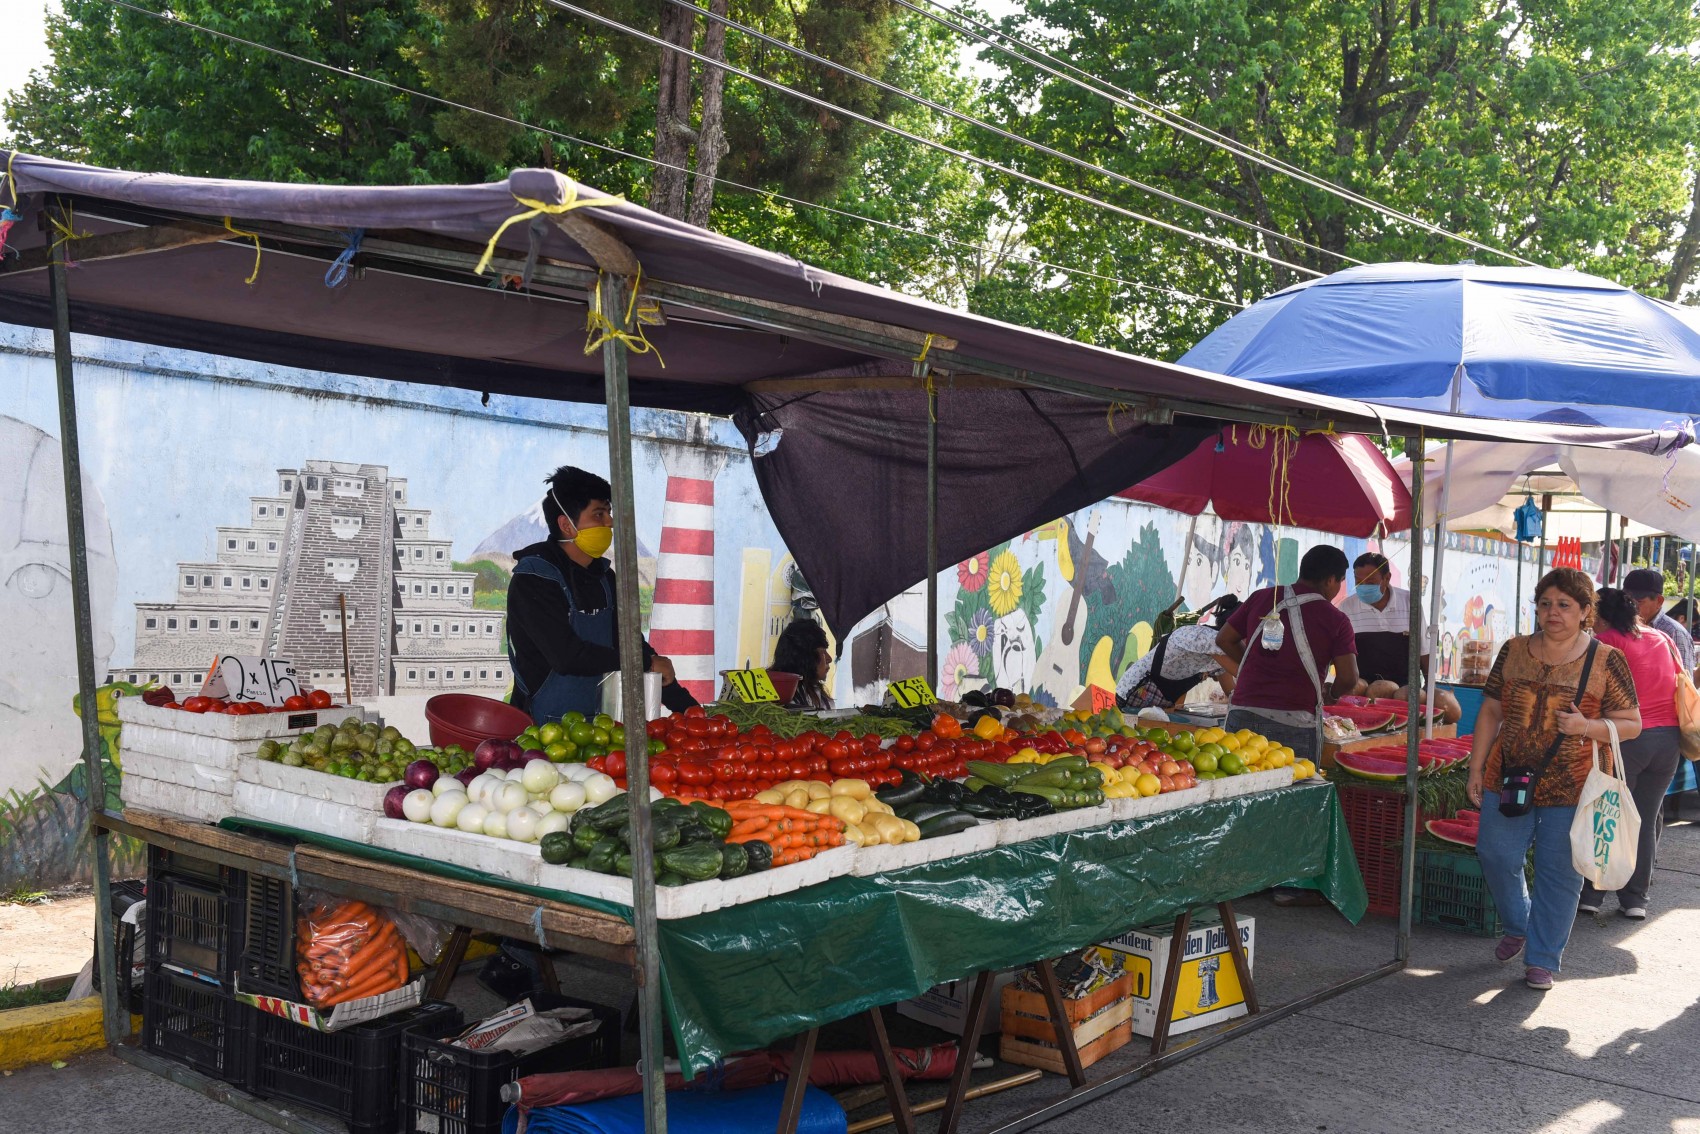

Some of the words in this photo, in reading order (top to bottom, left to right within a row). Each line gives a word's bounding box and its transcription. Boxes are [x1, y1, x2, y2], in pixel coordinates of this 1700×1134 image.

[221, 655, 256, 700] 2
[735, 669, 766, 701] 12
[891, 680, 922, 707] 13
[1184, 934, 1203, 956] den
